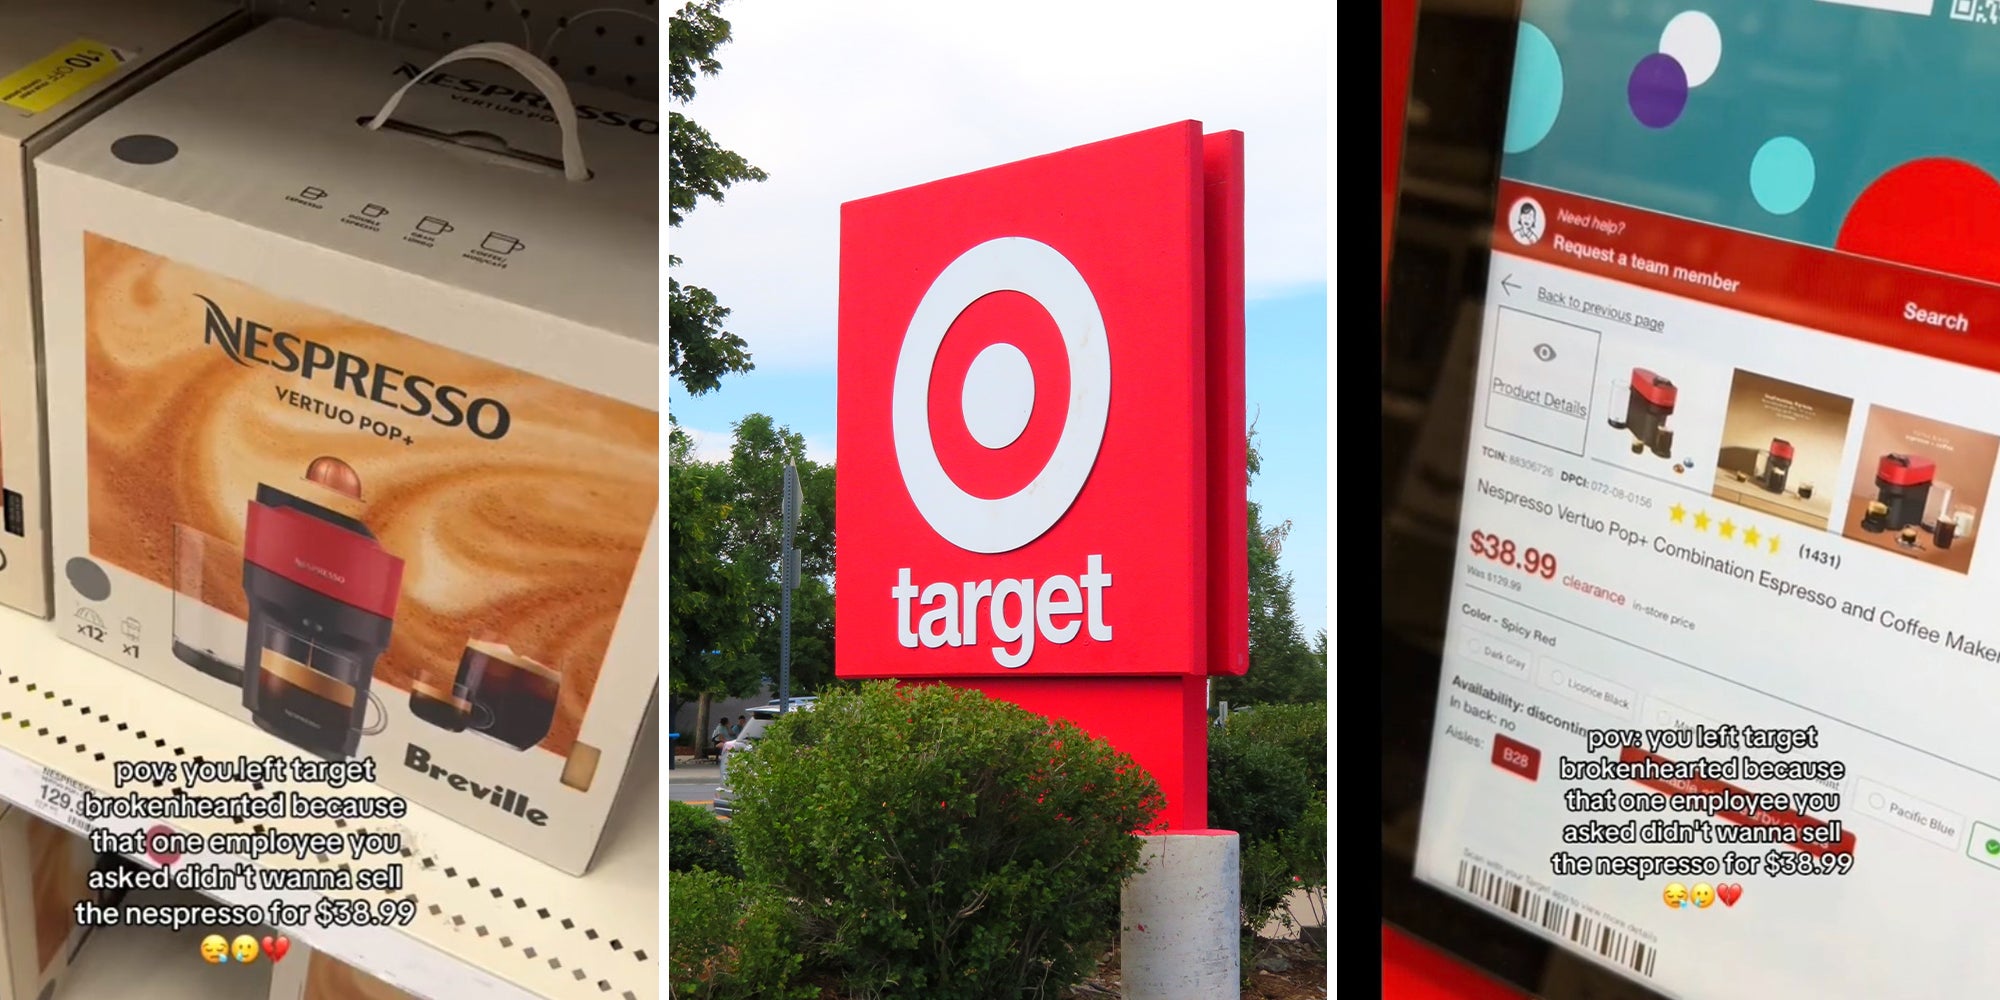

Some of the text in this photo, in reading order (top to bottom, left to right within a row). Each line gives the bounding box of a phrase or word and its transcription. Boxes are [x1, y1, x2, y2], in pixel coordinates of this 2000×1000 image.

[392, 61, 659, 135] NESPRSSO
[450, 94, 560, 126] VERTUO PO
[285, 195, 323, 210] ESPRESSO
[340, 217, 380, 232] ESPRESSO
[348, 214, 381, 227] DOUBLE
[411, 232, 435, 242] GRAN
[1557, 208, 1626, 236] Need help?
[403, 236, 434, 248] LUNGO
[1553, 233, 1741, 293] Request a team member
[1537, 286, 1666, 333] Back to previous page
[1903, 301, 1970, 333] Search
[192, 292, 511, 440] NESPRESSO
[275, 385, 414, 446] VERTUO POP+
[1492, 377, 1588, 419] Product Details
[1482, 445, 1508, 462] TCIN:
[1560, 470, 1590, 489] DPCI:
[1591, 480, 1653, 509] 072-08-0156
[294, 557, 346, 584] NESPRESSO
[1477, 478, 1553, 518] Nespresso
[1557, 504, 1605, 533] Vertuo
[1608, 520, 1649, 548] Pop+
[1653, 536, 1755, 584] Combination
[1758, 569, 1838, 610] Espresso
[1841, 601, 1877, 623] and
[1879, 610, 1940, 645] Coffee
[1798, 544, 1842, 570] (1431)
[1466, 565, 1523, 593] Was $129.99
[1470, 529, 1697, 631] $38.99 clearance in-store price
[891, 554, 1113, 669] target
[1462, 603, 1491, 623] Color
[1501, 617, 1531, 639] Spicy
[1533, 629, 1557, 648] Red
[1484, 646, 1526, 672] Dark Gray
[1452, 674, 1589, 739] Availability: discontin
[1567, 678, 1631, 711] Licorice Black
[1450, 695, 1516, 733] In back: no
[1445, 724, 1485, 750] Aisles:
[1503, 748, 1529, 768] B28
[404, 742, 549, 827] Breville
[40, 784, 95, 821] 129.9
[1890, 802, 1955, 837] Pacific Blue
